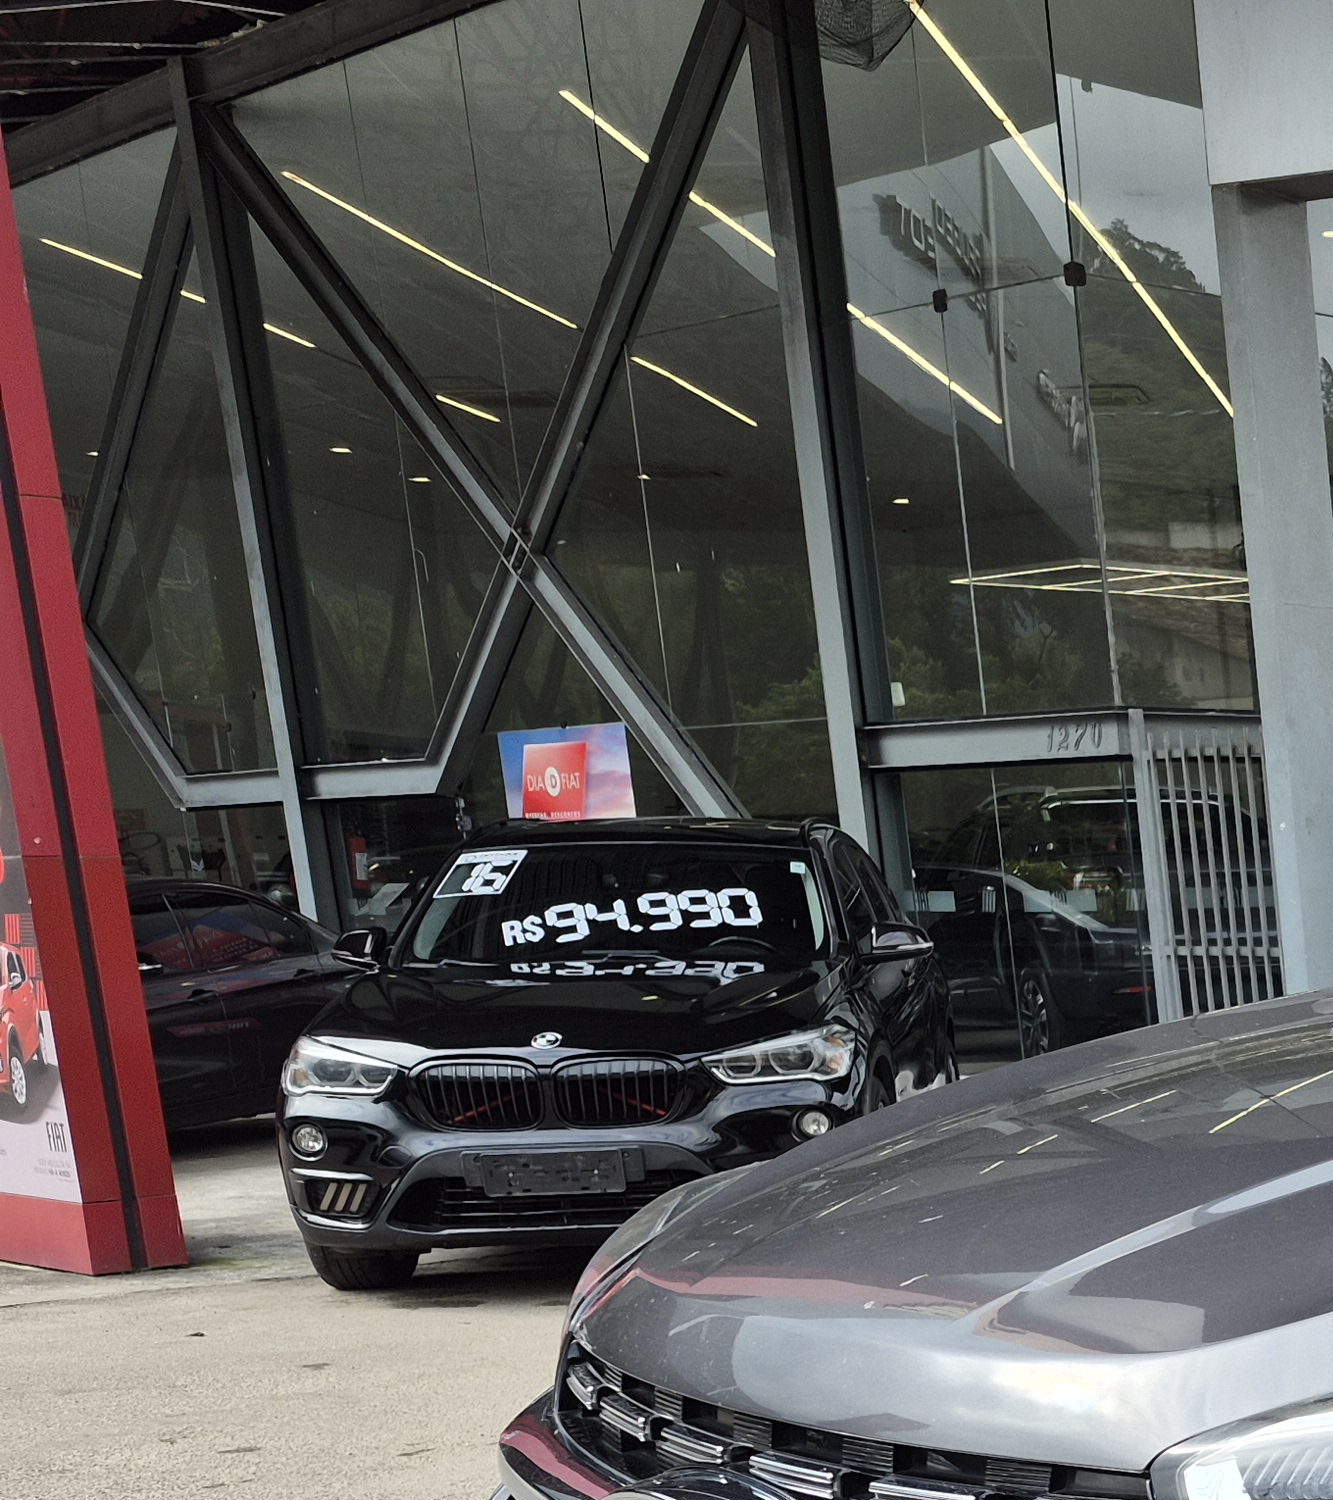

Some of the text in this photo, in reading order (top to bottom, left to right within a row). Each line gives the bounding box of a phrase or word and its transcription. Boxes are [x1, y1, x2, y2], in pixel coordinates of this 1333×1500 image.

[1046, 721, 1103, 753] 1270
[527, 774, 546, 792] DIA
[560, 772, 581, 790] FIAT
[461, 860, 514, 893] 16
[45, 1121, 68, 1153] FIAT
